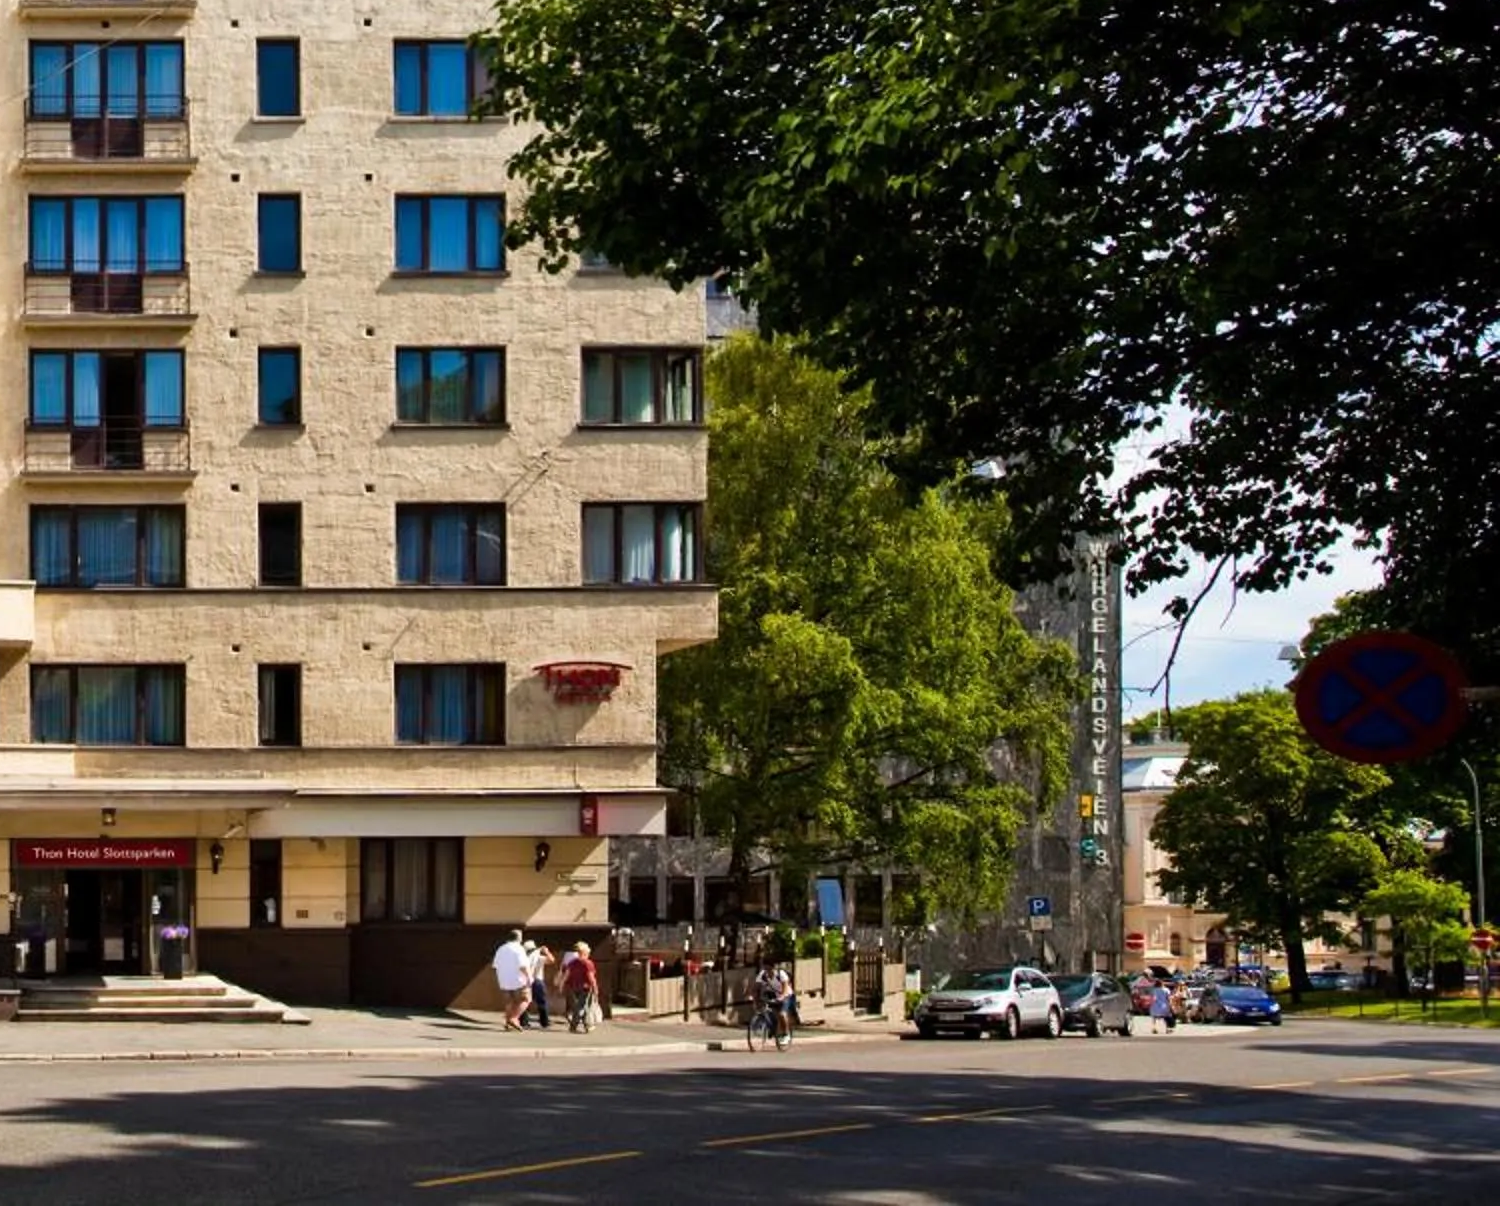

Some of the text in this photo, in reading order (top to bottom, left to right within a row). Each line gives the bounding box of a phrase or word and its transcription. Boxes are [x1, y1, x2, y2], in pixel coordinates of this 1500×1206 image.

[32, 847, 175, 861] Thon Hotel Slottsparken
[1033, 899, 1045, 914] P
